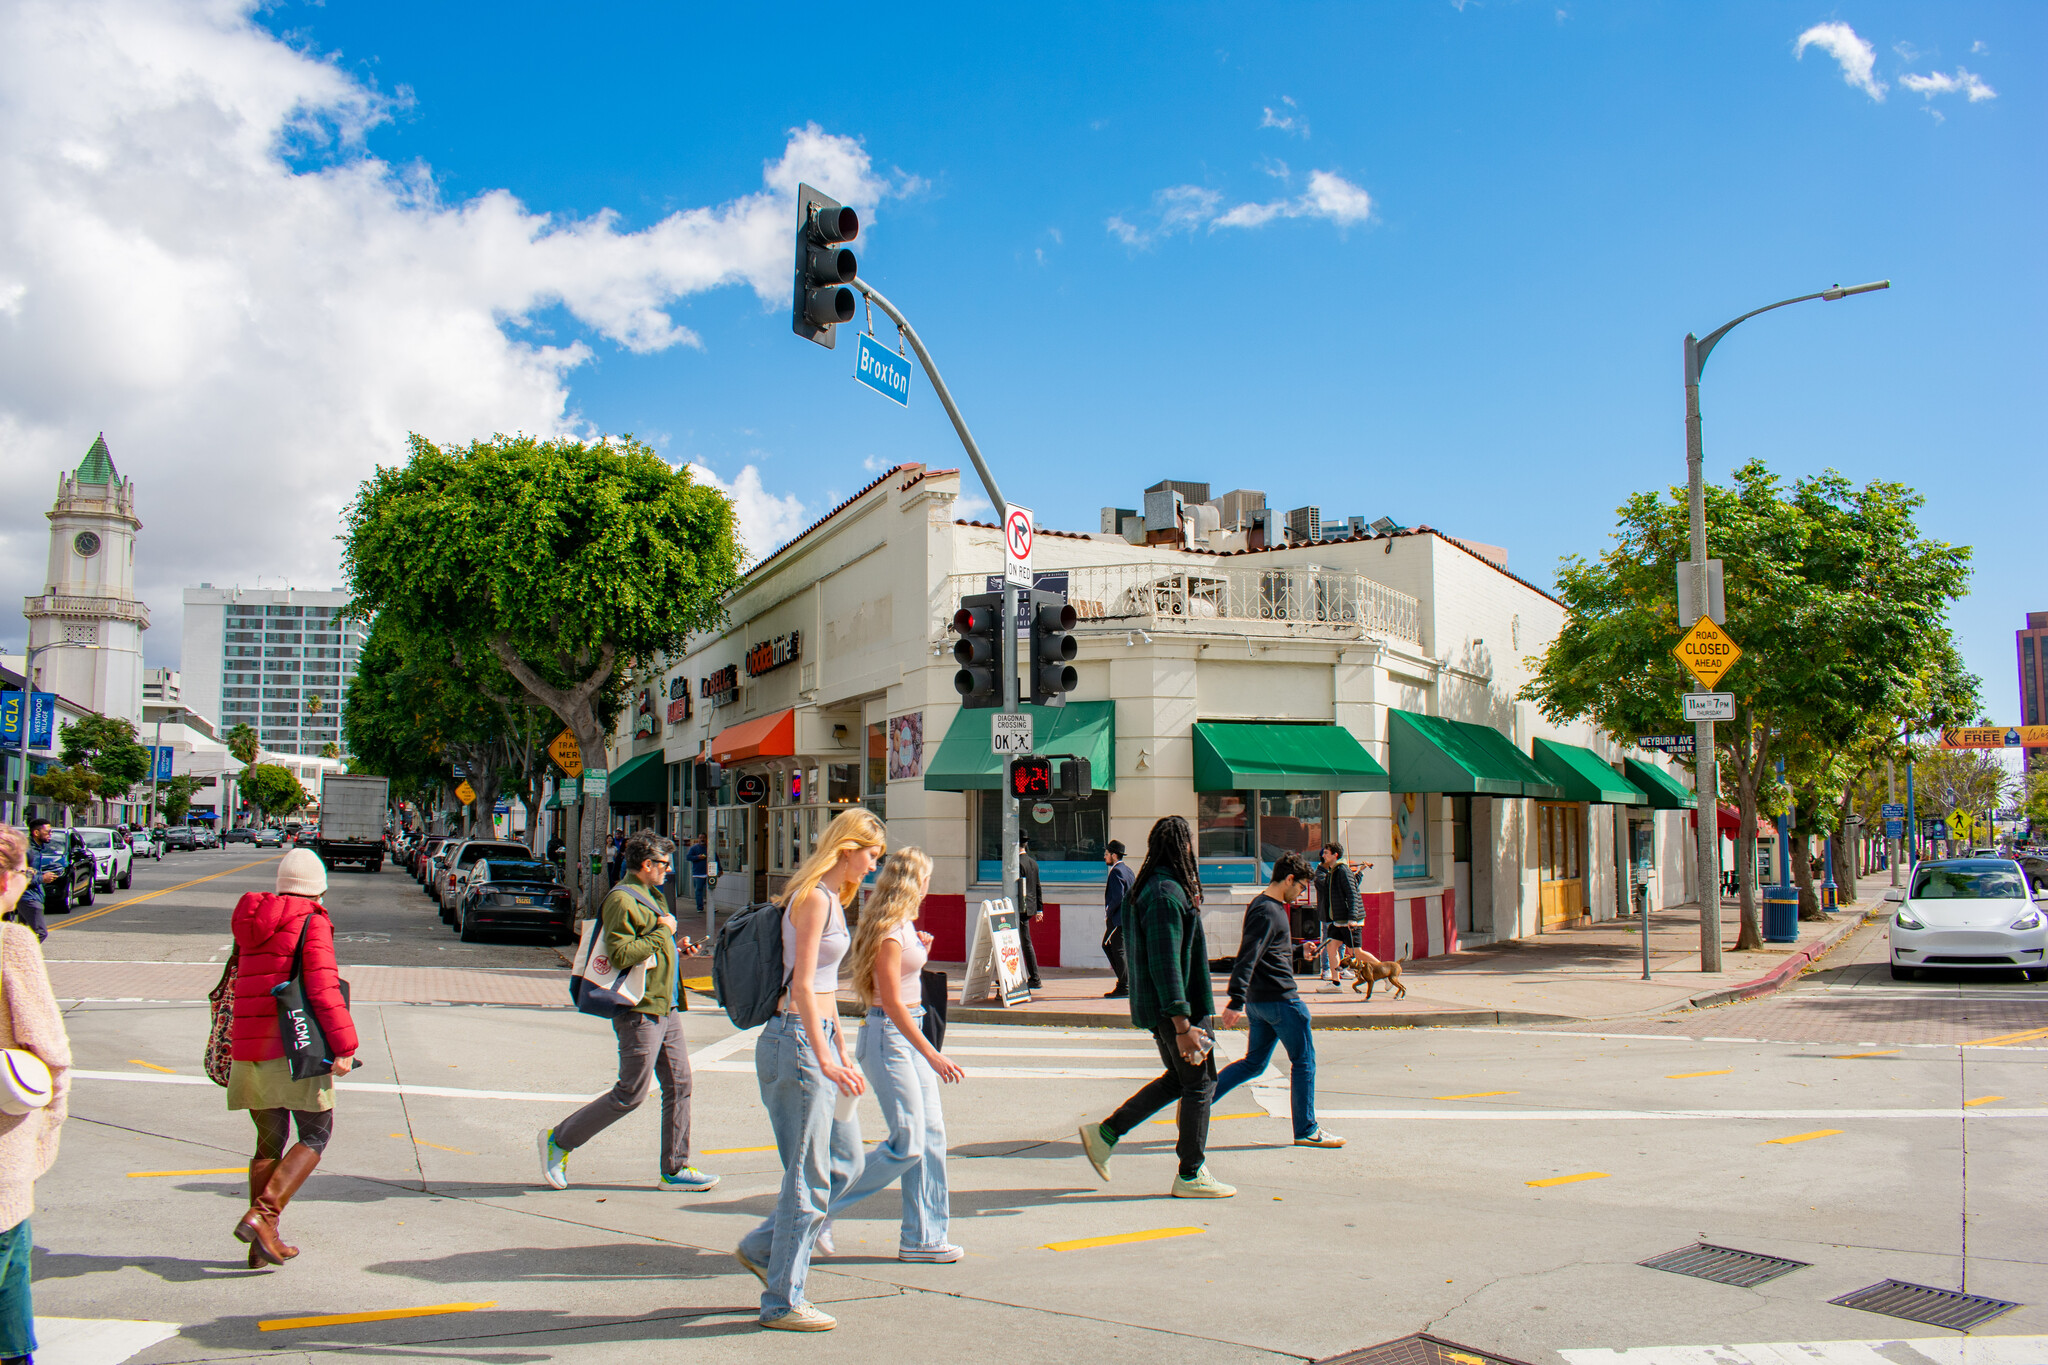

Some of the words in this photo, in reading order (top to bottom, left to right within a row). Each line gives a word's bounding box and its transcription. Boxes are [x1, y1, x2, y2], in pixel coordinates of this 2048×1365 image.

[861, 346, 907, 394] Broxton
[1008, 562, 1017, 577] ON
[1018, 565, 1031, 581] RED
[1695, 631, 1718, 640] ROAD
[1685, 643, 1729, 655] CLOSED
[1694, 659, 1722, 667] AHEAD
[1713, 698, 1730, 709] 7PM
[4, 698, 19, 733] UCLA
[34, 698, 42, 735] WESTWOOD
[41, 710, 49, 735] VILLAGE
[997, 714, 1027, 722] DIAGONAL
[997, 721, 1027, 729] CROSSING
[994, 733, 1010, 750] OK
[1639, 736, 1677, 746] WEYBURN
[1964, 733, 2001, 742] FREE
[1031, 767, 1048, 791] 24
[291, 1008, 312, 1050] LACMA
